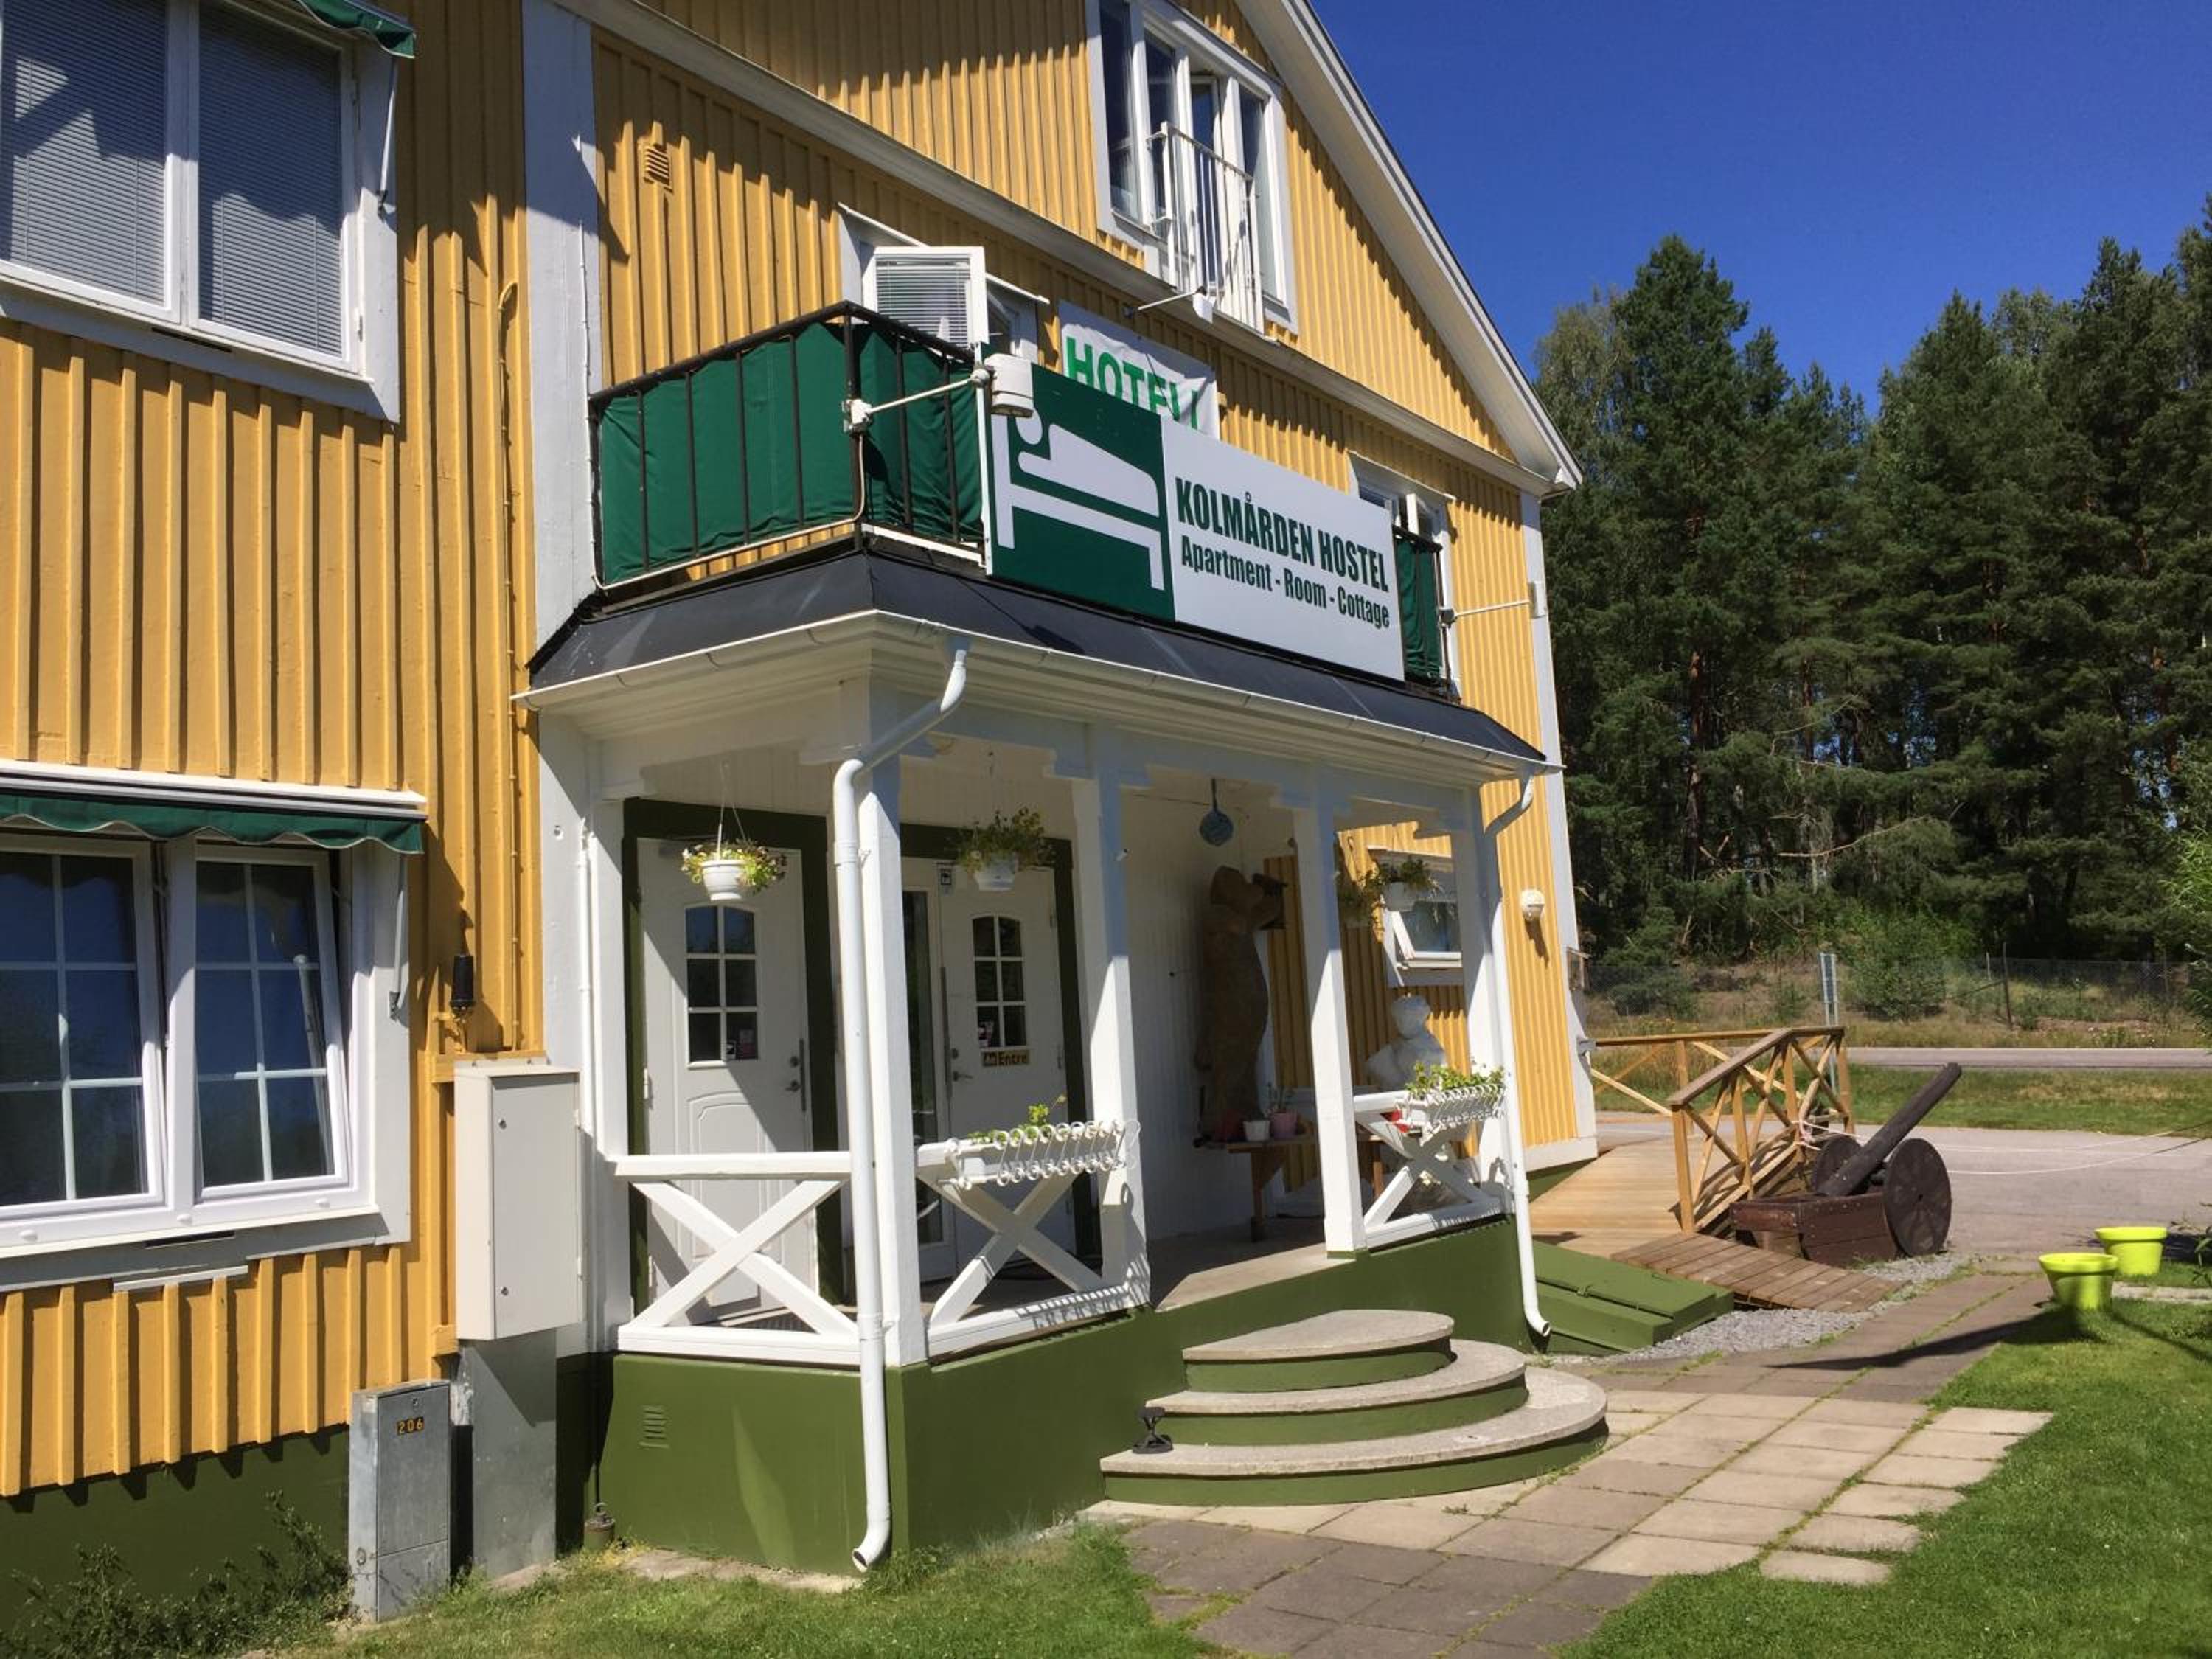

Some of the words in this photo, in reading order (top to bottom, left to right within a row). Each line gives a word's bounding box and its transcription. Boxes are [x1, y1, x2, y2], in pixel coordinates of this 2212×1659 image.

[1175, 476, 1315, 567] KOLMÅRDEN
[1318, 529, 1389, 593] HOSTEL
[1181, 535, 1273, 592] Apartment
[1284, 568, 1327, 610] Room
[1337, 586, 1390, 630] Cottage
[398, 1417, 423, 1435] 206
